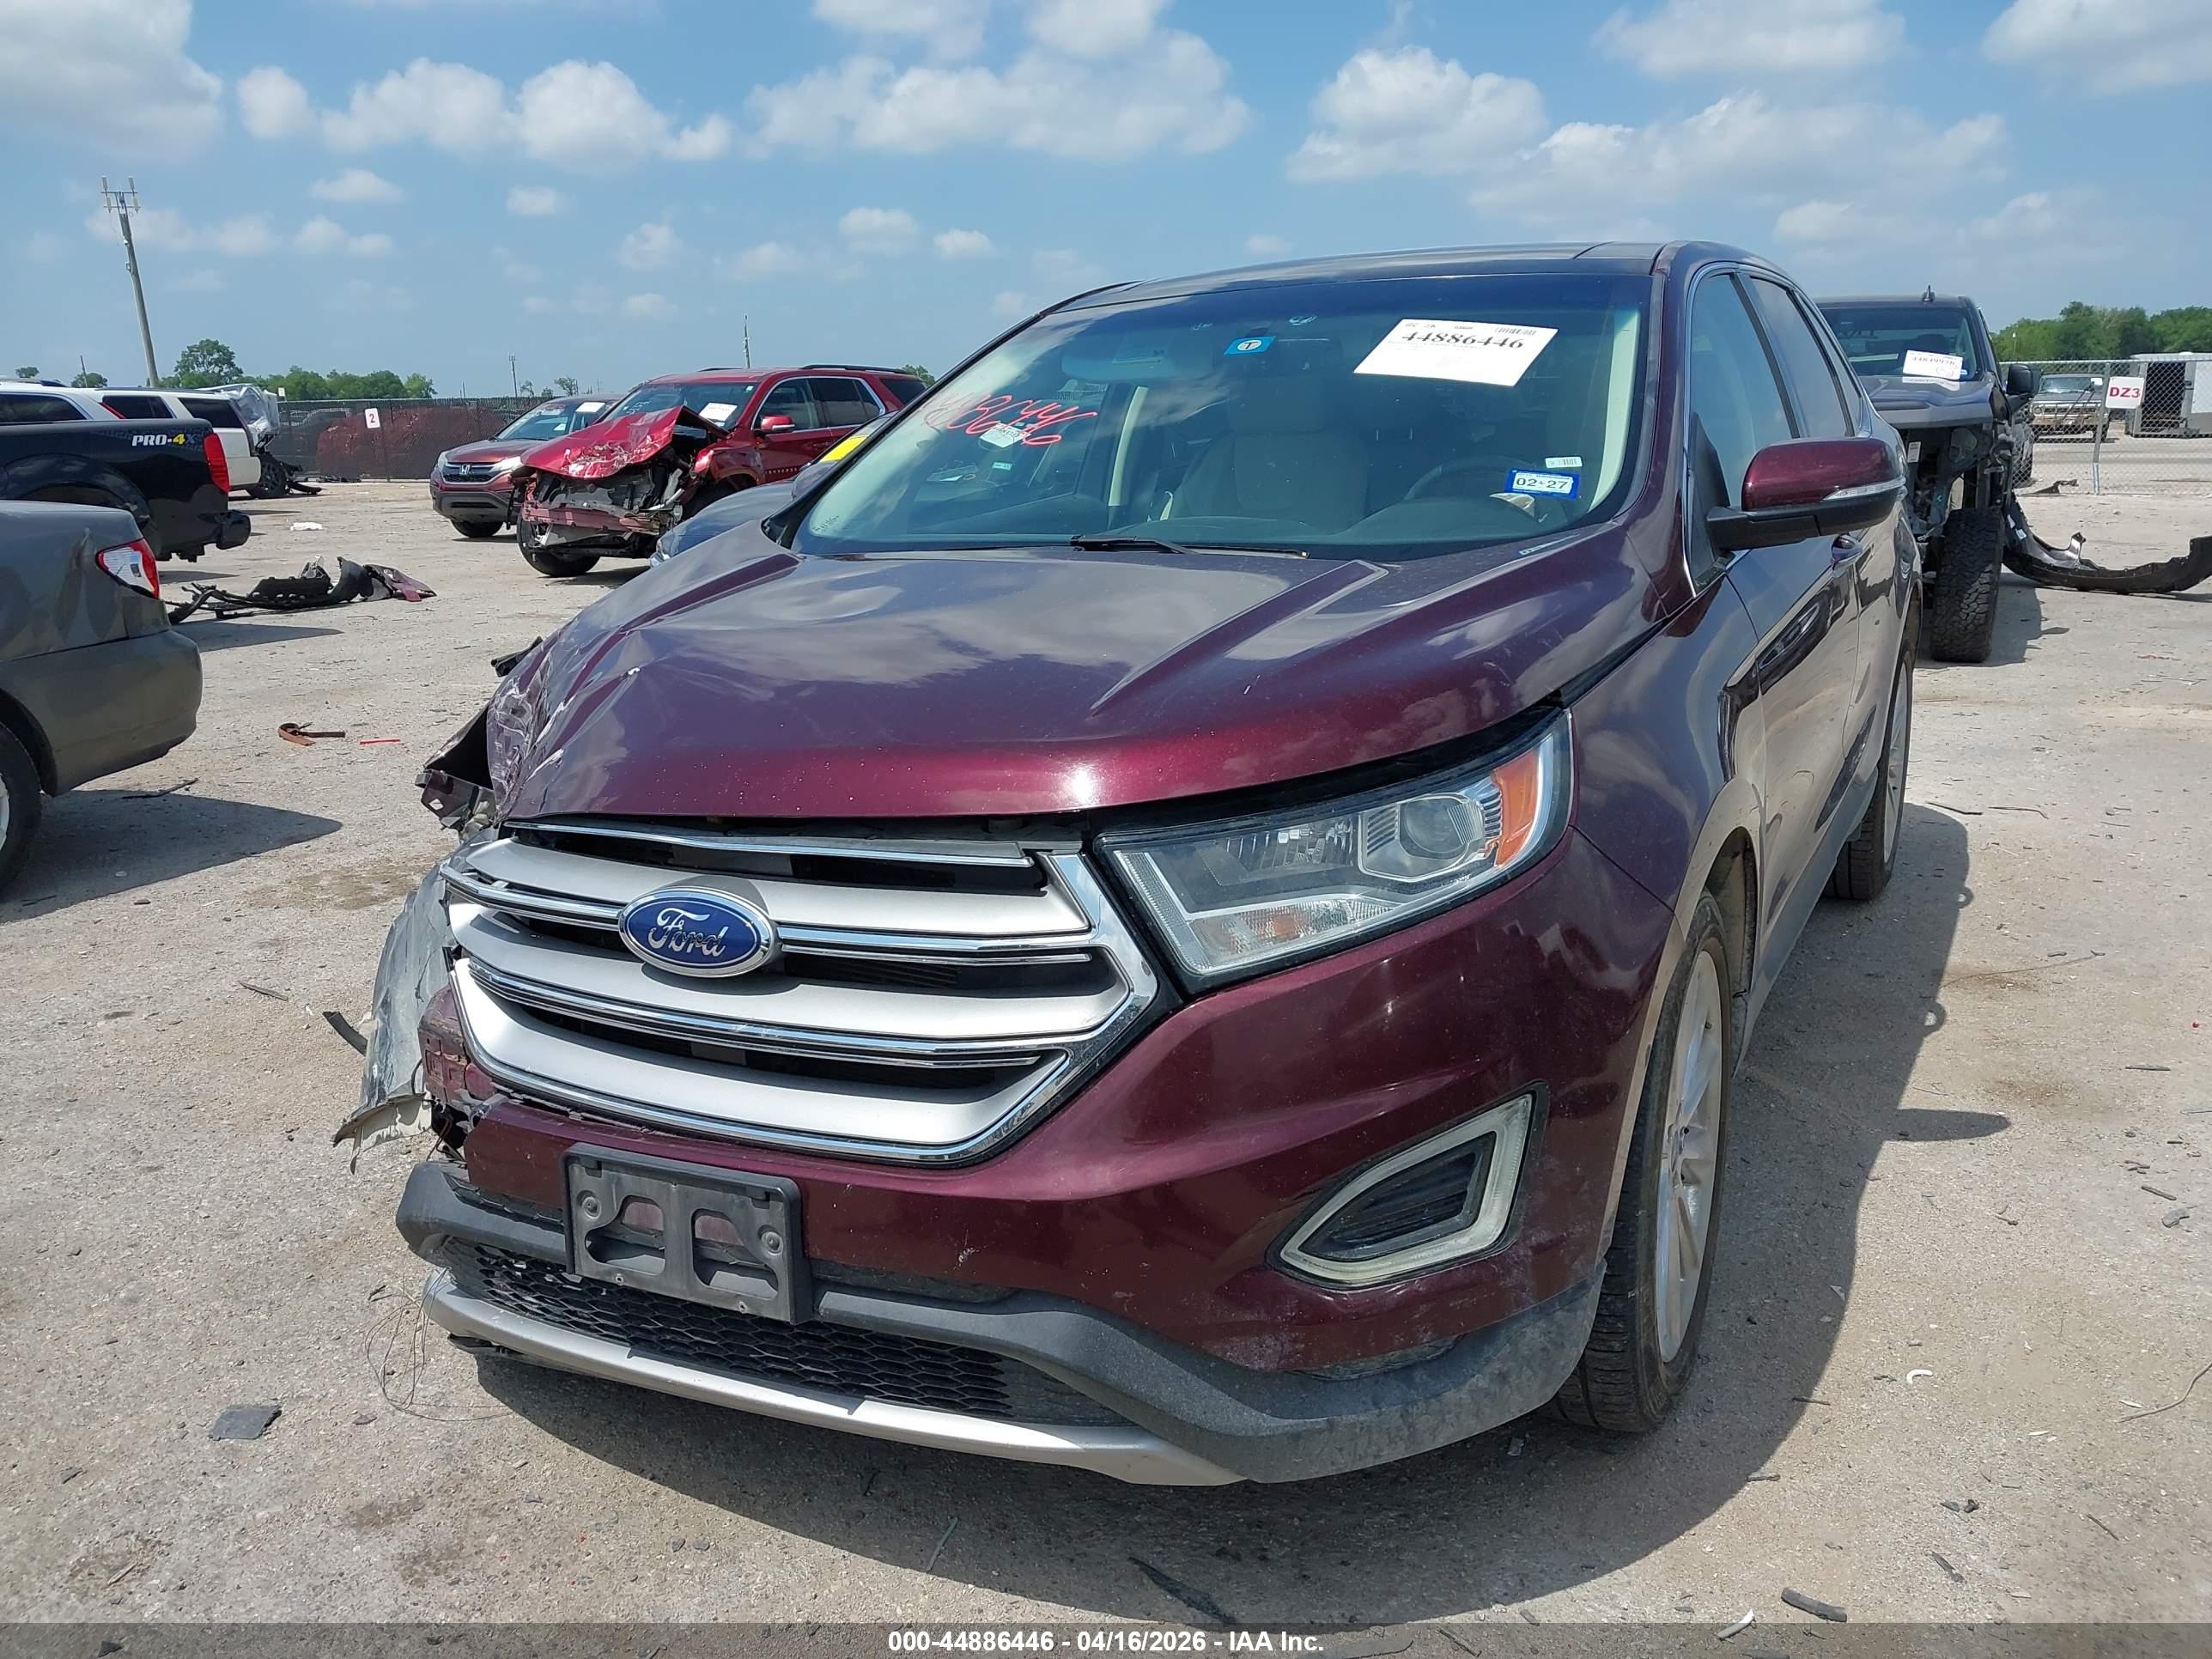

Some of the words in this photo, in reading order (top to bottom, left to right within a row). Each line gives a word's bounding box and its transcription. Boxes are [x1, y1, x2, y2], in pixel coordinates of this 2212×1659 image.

[1401, 331, 1524, 349] 44886446
[2109, 386, 2141, 398] DZ3
[369, 413, 376, 423] 2
[647, 907, 729, 957] Ford
